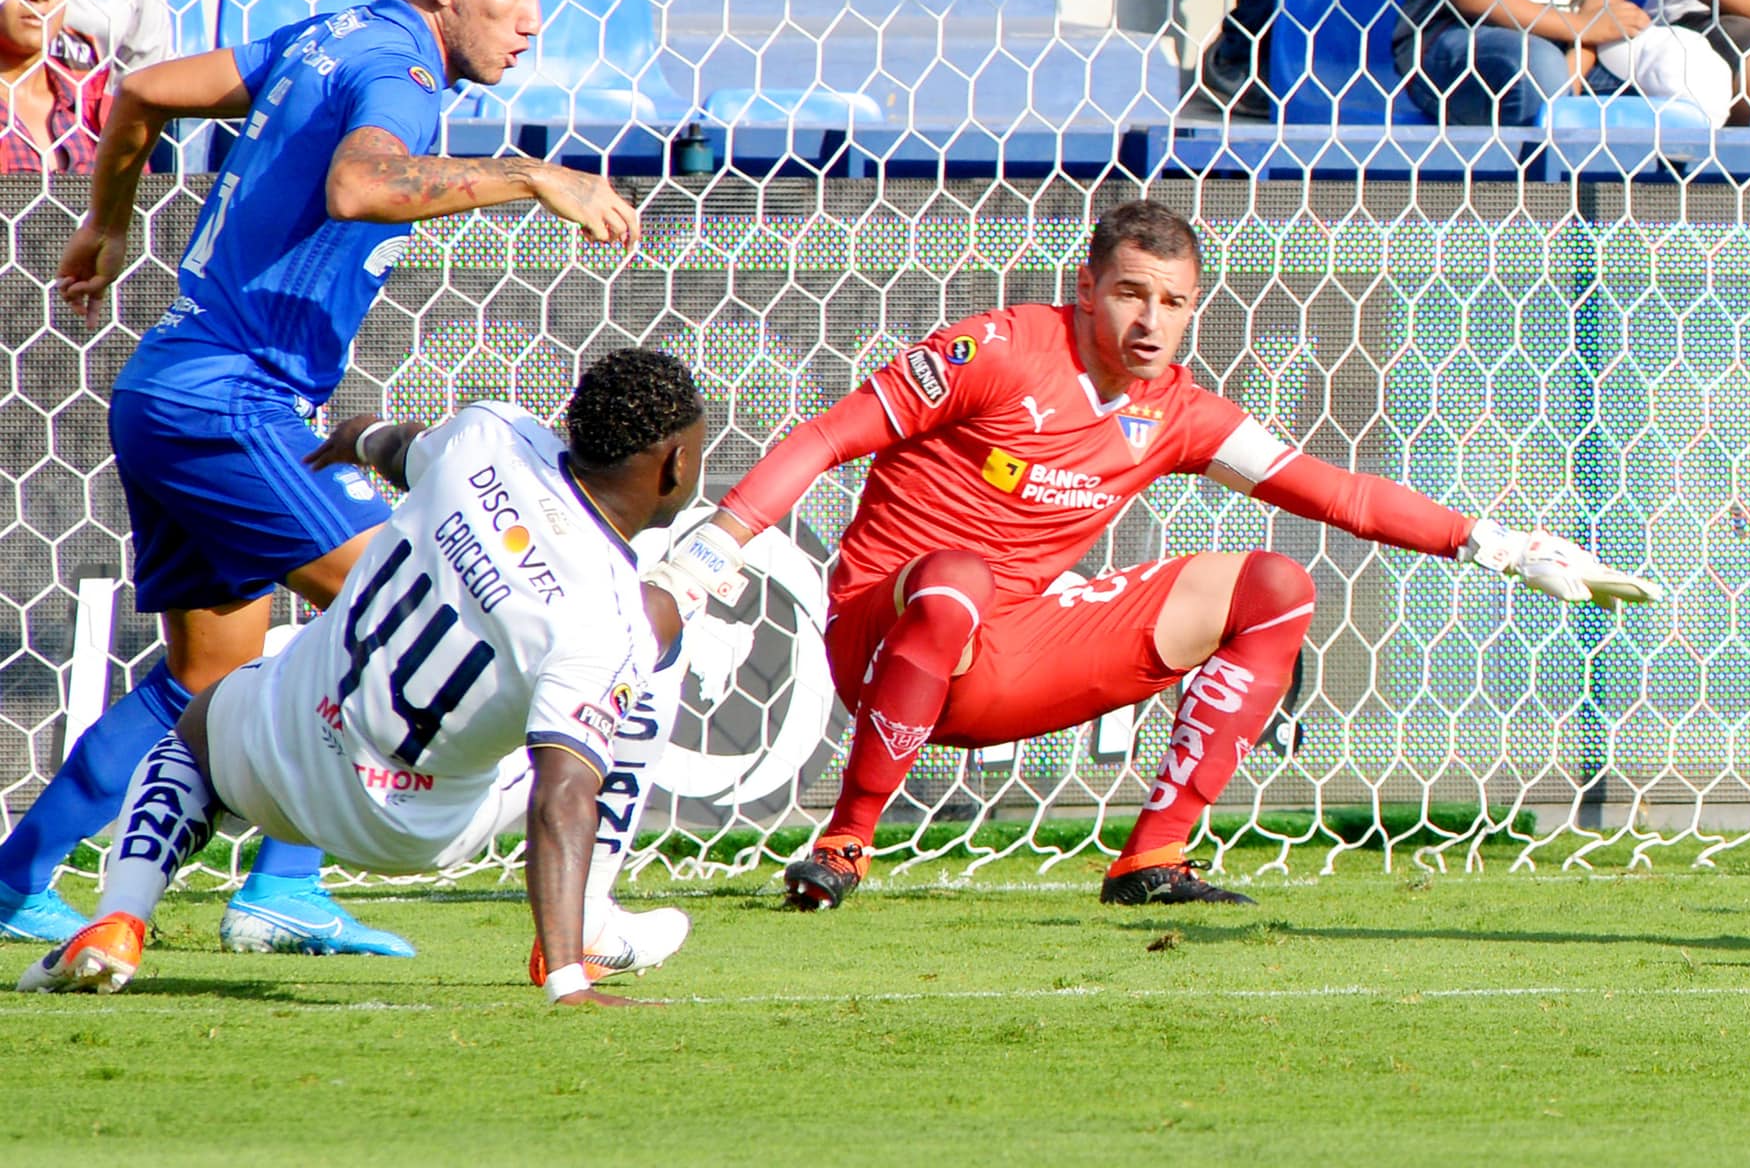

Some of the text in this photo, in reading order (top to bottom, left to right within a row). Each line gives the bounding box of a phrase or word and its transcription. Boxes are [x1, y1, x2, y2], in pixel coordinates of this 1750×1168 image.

[468, 465, 566, 605] DISCOVER
[1030, 464, 1102, 490] BANCO
[433, 510, 512, 614] CAICEDO
[339, 538, 496, 768] 44
[1142, 655, 1255, 811] ROLAND
